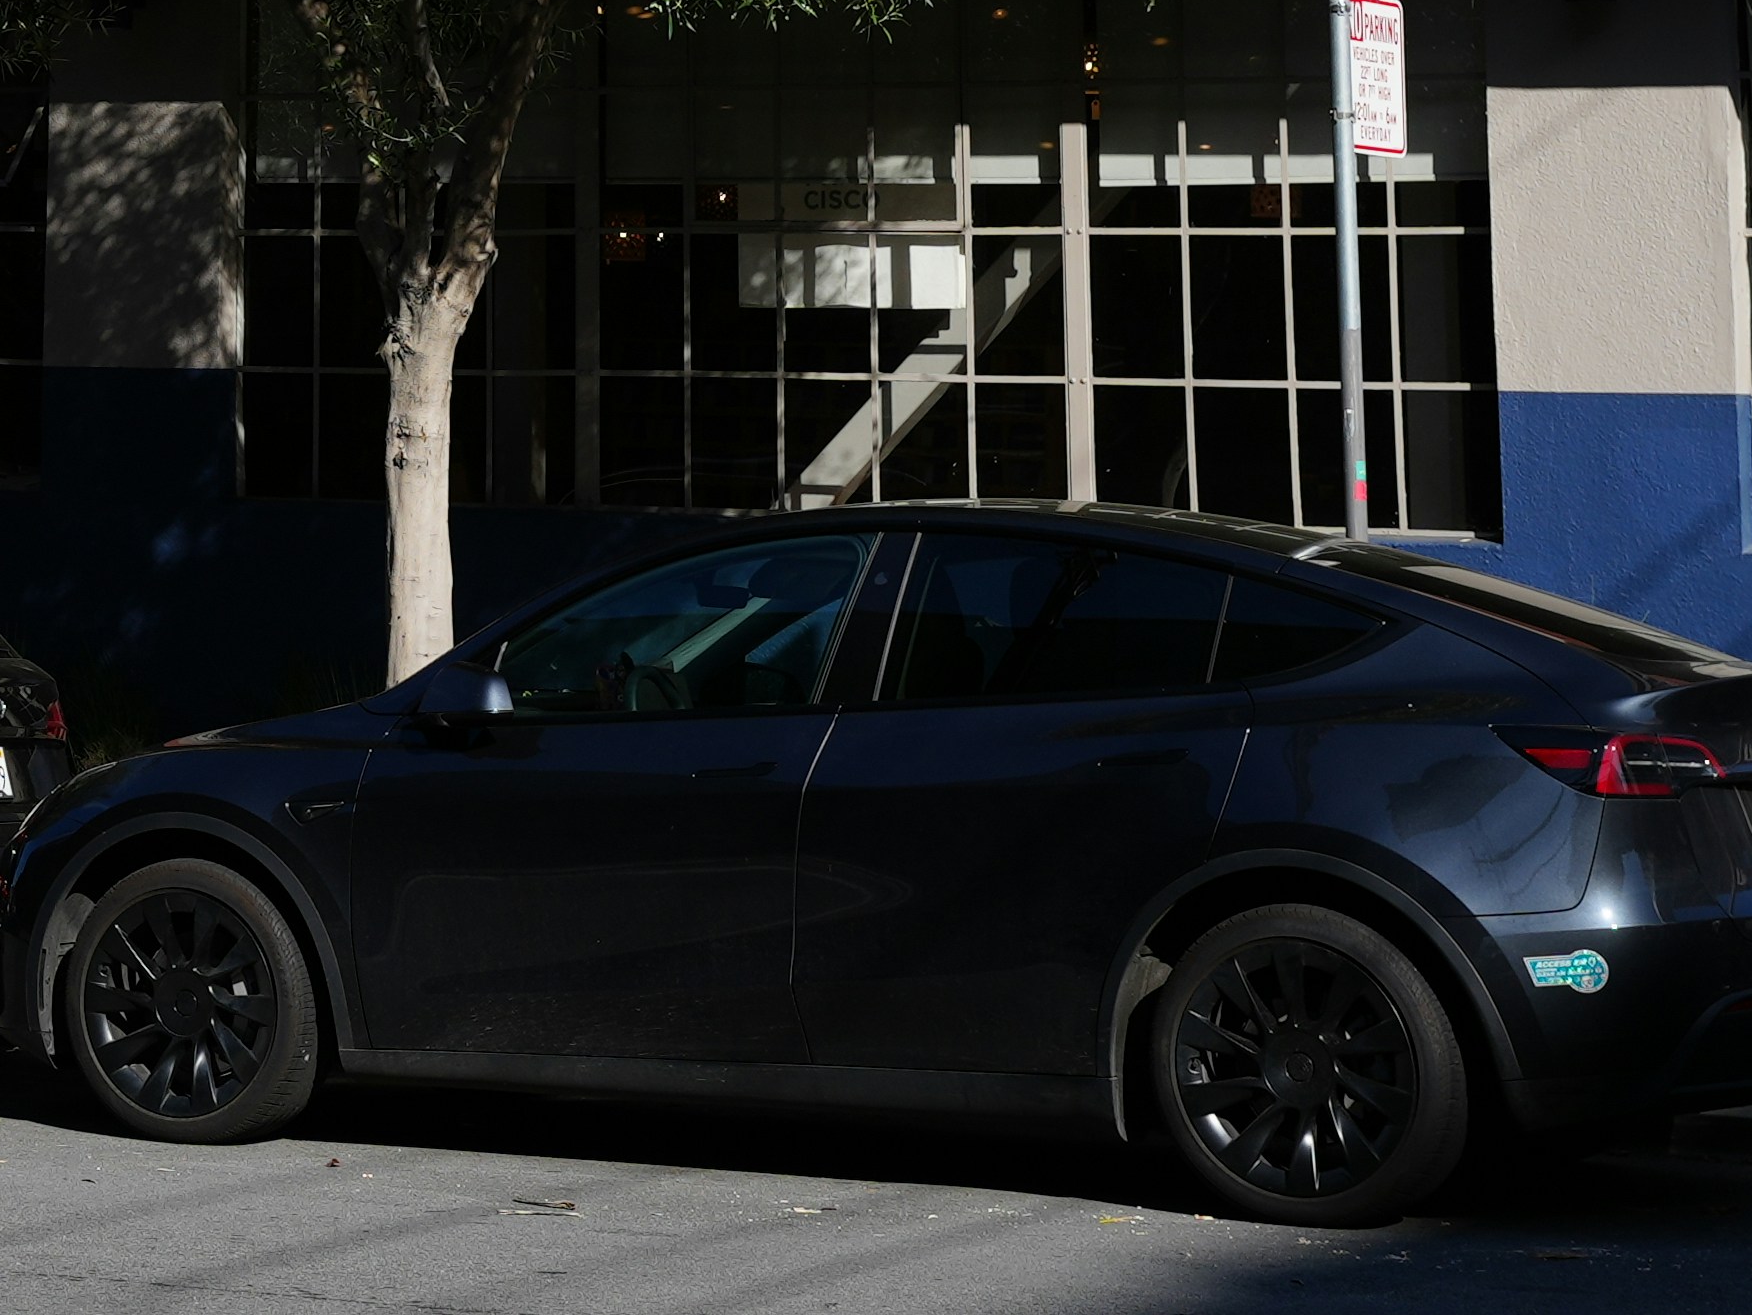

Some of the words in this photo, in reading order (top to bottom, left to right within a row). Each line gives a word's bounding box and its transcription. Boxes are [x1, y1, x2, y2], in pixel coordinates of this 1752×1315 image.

[1364, 13, 1399, 46] PARKING
[1353, 46, 1378, 63] VEHICLES
[1381, 50, 1395, 66] OVER
[1374, 67, 1388, 83] LONG
[1360, 125, 1391, 142] EVERYDAY
[804, 190, 880, 210] CISCO
